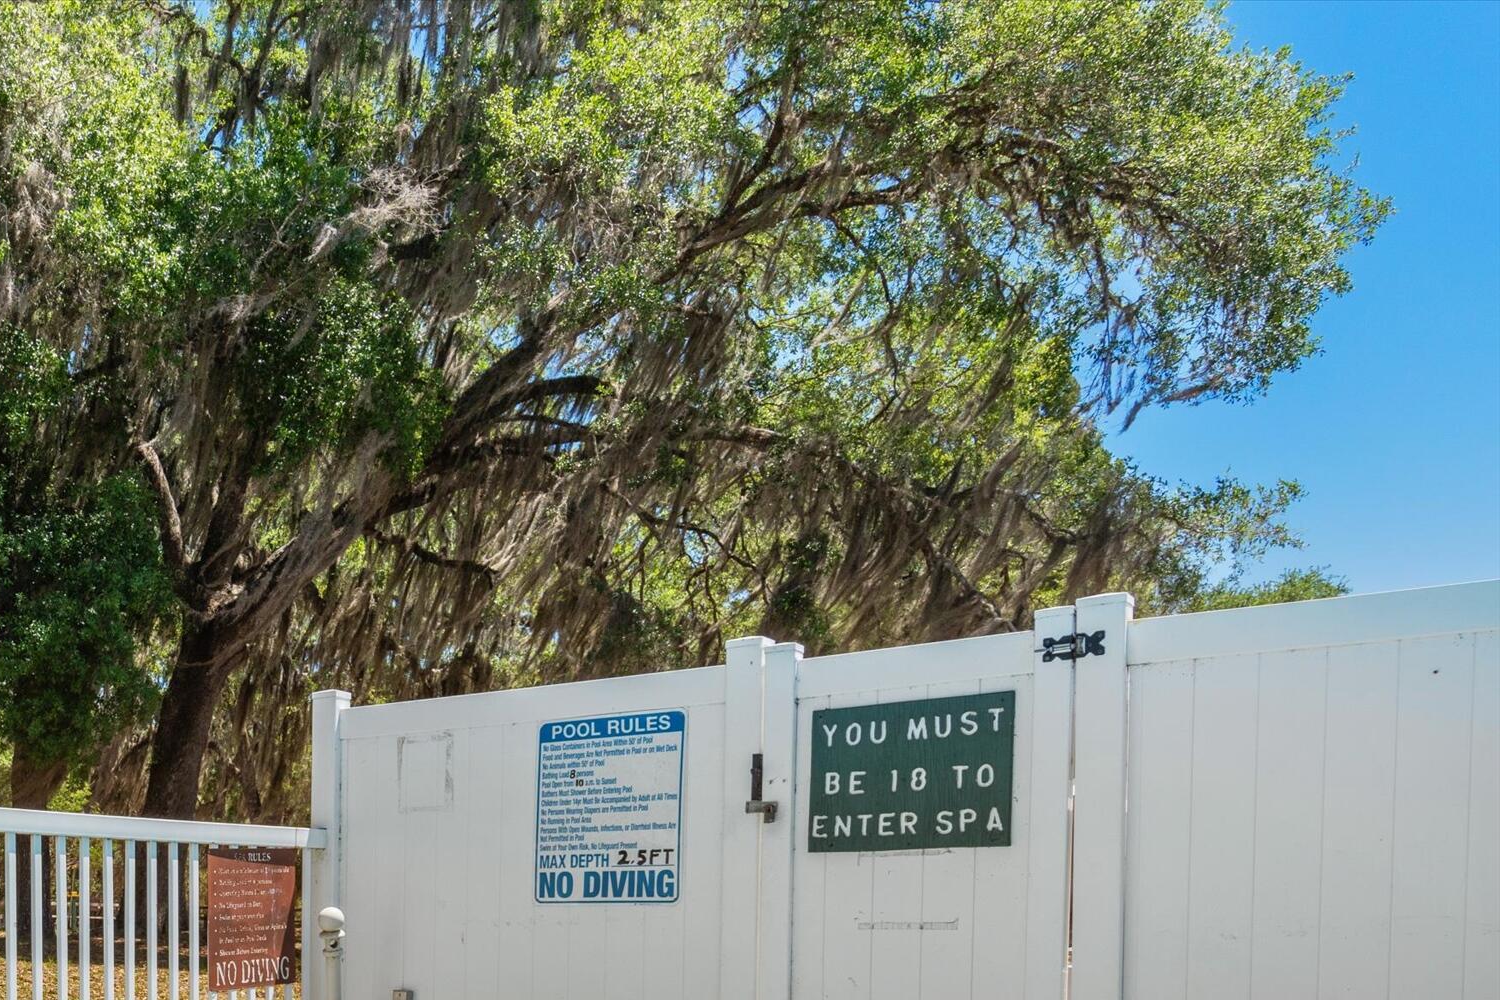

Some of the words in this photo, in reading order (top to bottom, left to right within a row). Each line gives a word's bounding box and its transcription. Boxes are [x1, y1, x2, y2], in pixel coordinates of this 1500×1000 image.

[551, 722, 600, 740] POOL
[607, 715, 671, 735] RULES
[822, 720, 887, 747] YOU
[907, 707, 1005, 740] MUST
[643, 736, 653, 744] Pool
[564, 752, 585, 760] Beverages
[604, 749, 625, 757] Permitted
[595, 759, 604, 767] Pool
[542, 772, 558, 780] Bathing
[570, 769, 576, 779] 8
[576, 770, 594, 778] persons
[825, 771, 867, 795] BE
[891, 767, 927, 793] 18
[952, 763, 994, 789] TO
[552, 780, 562, 788] Open
[576, 779, 584, 787] 10
[603, 787, 621, 795] Entering
[812, 811, 918, 838] ENTER
[936, 807, 1004, 835] SPA
[248, 852, 271, 862] RULES
[540, 855, 566, 868] MAX
[570, 854, 609, 868] DEPTH
[539, 871, 574, 898] NO
[583, 869, 675, 898] DIVING
[216, 961, 237, 986] NO
[241, 956, 290, 984] DIVING
